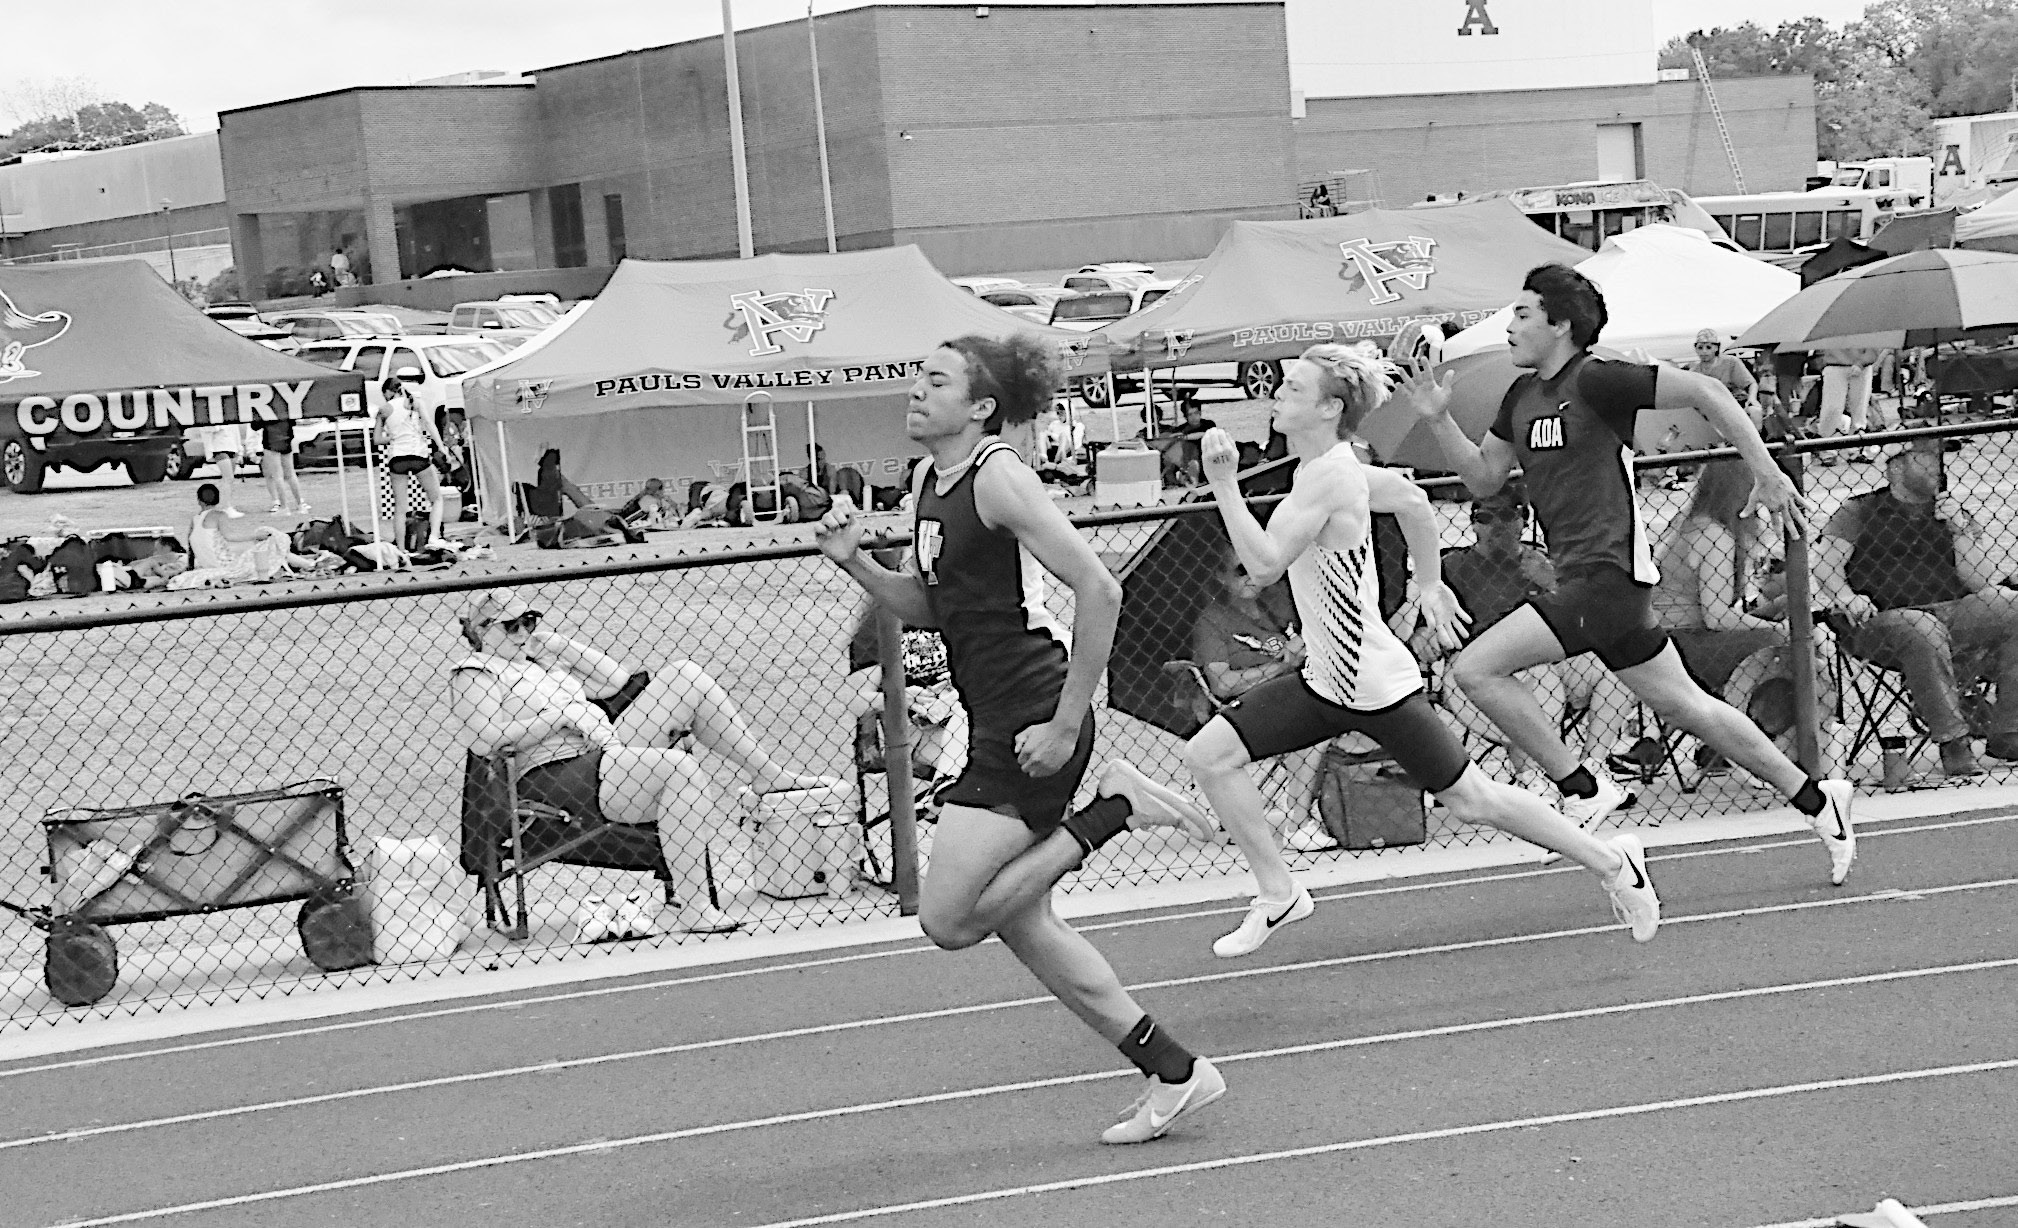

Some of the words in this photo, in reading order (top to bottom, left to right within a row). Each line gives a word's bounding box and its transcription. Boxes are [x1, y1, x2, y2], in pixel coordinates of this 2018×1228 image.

[1458, 0, 1498, 35] A
[1939, 144, 1966, 176] A
[1232, 321, 1335, 347] PAULS
[595, 373, 702, 398] PAULS
[711, 368, 834, 391] VALLEY
[16, 379, 315, 435] COUNTRY
[1530, 417, 1563, 449] ADA
